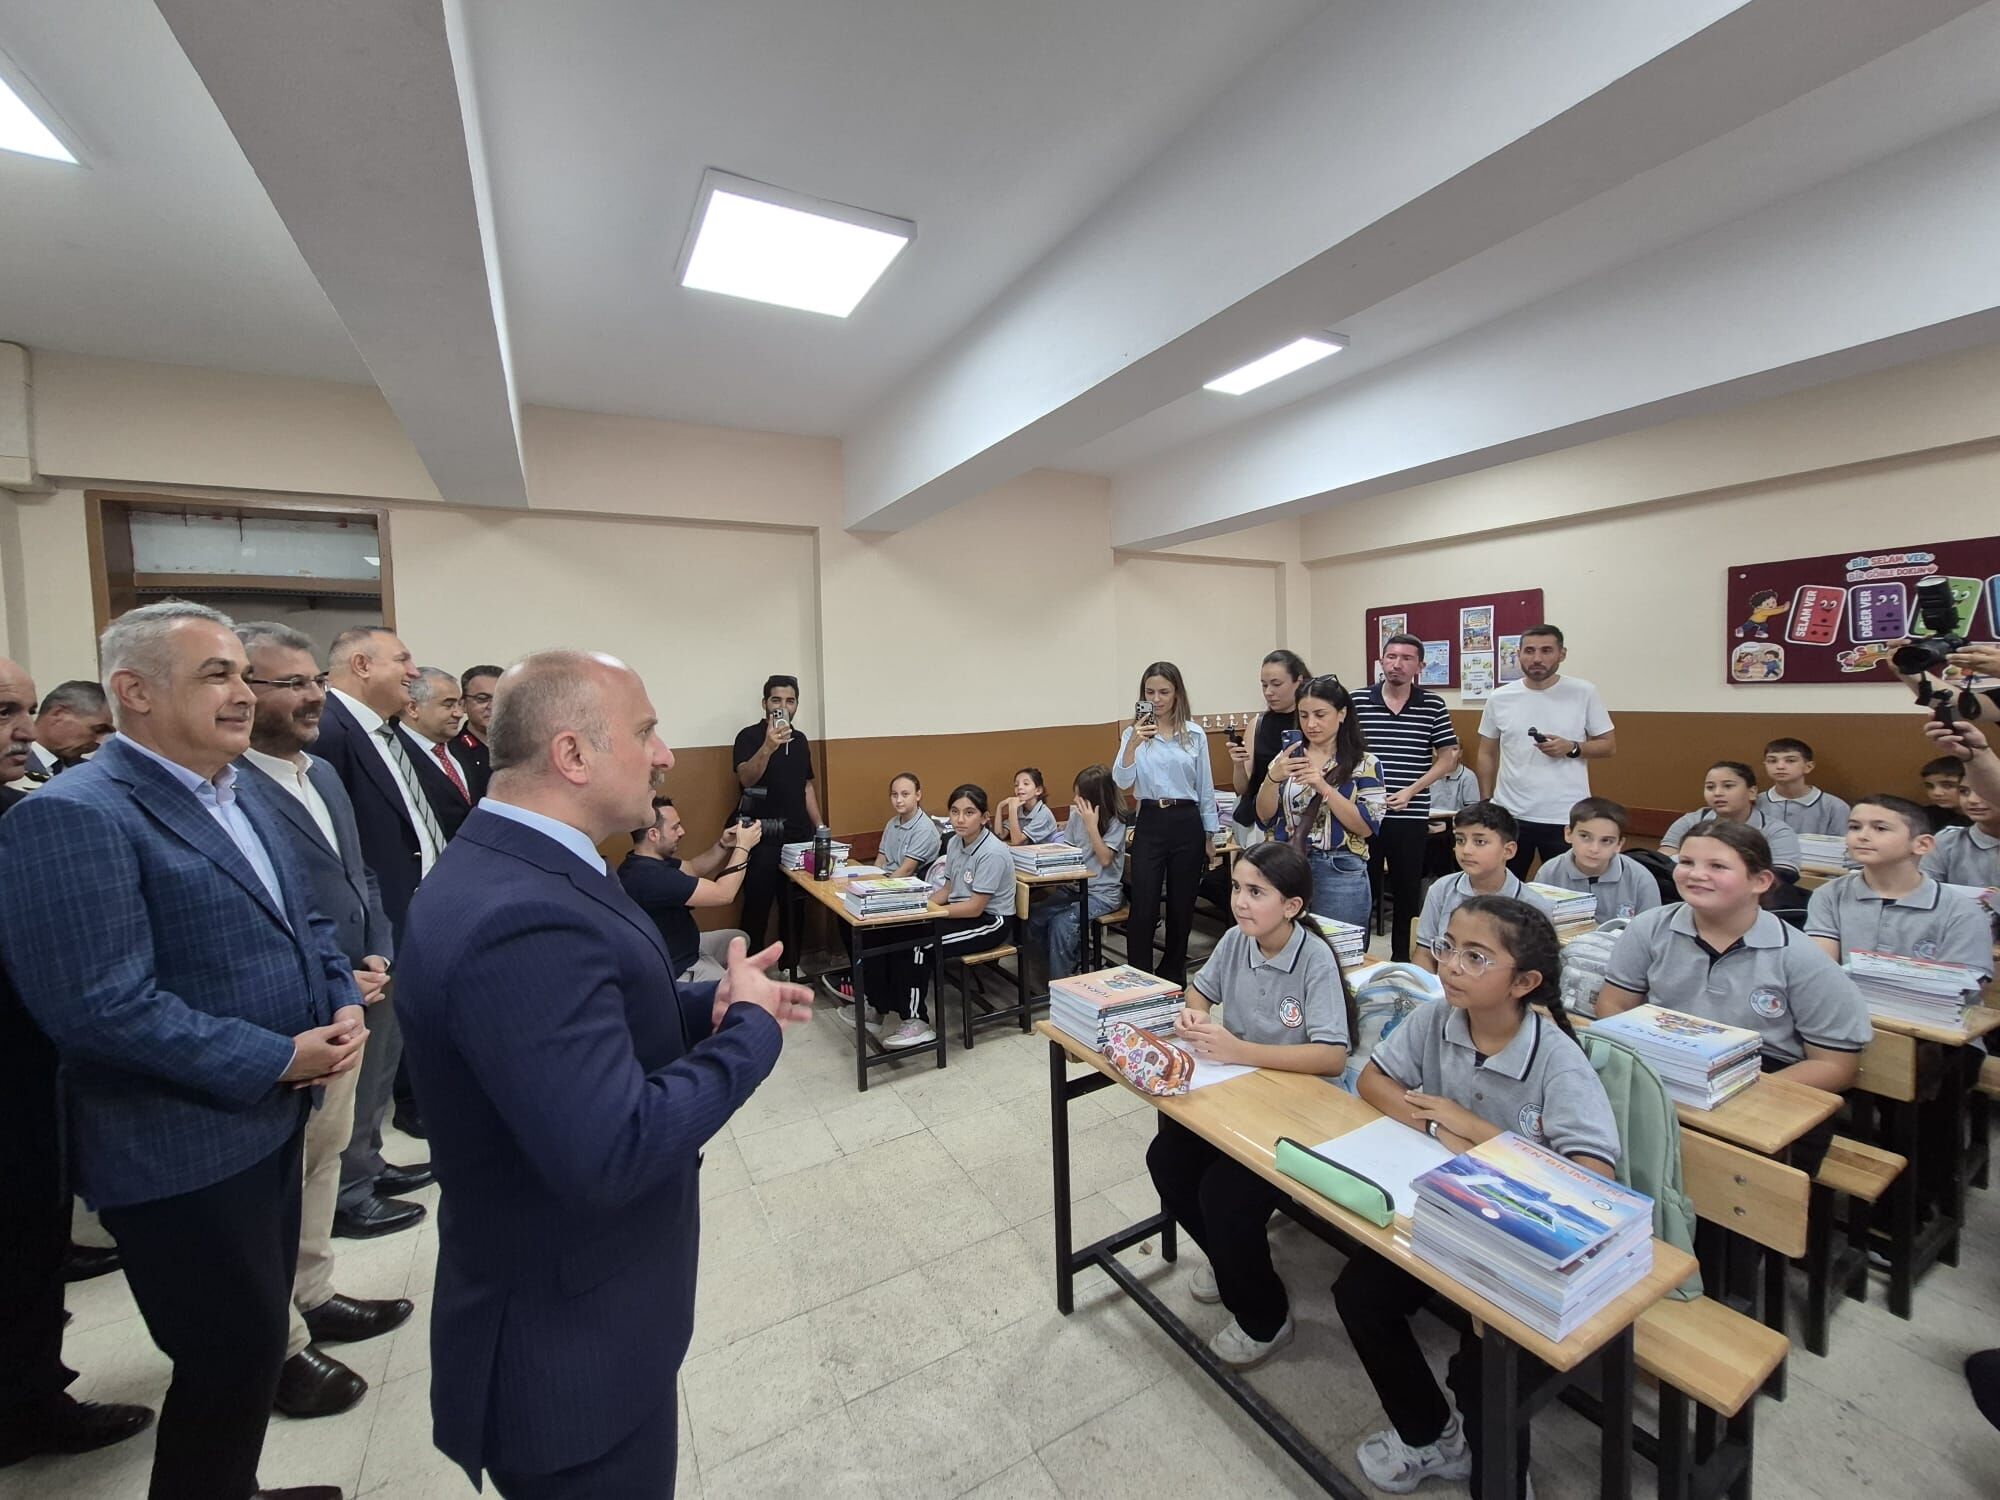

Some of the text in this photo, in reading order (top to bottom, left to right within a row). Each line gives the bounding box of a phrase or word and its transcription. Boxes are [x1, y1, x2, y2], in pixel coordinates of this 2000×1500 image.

[1871, 555, 1905, 565] SELAM
[1896, 566, 1927, 576] DOKUN
[1860, 590, 1872, 608] VER
[1795, 590, 1818, 637] SELAM VER
[1858, 609, 1873, 637] DEĞER
